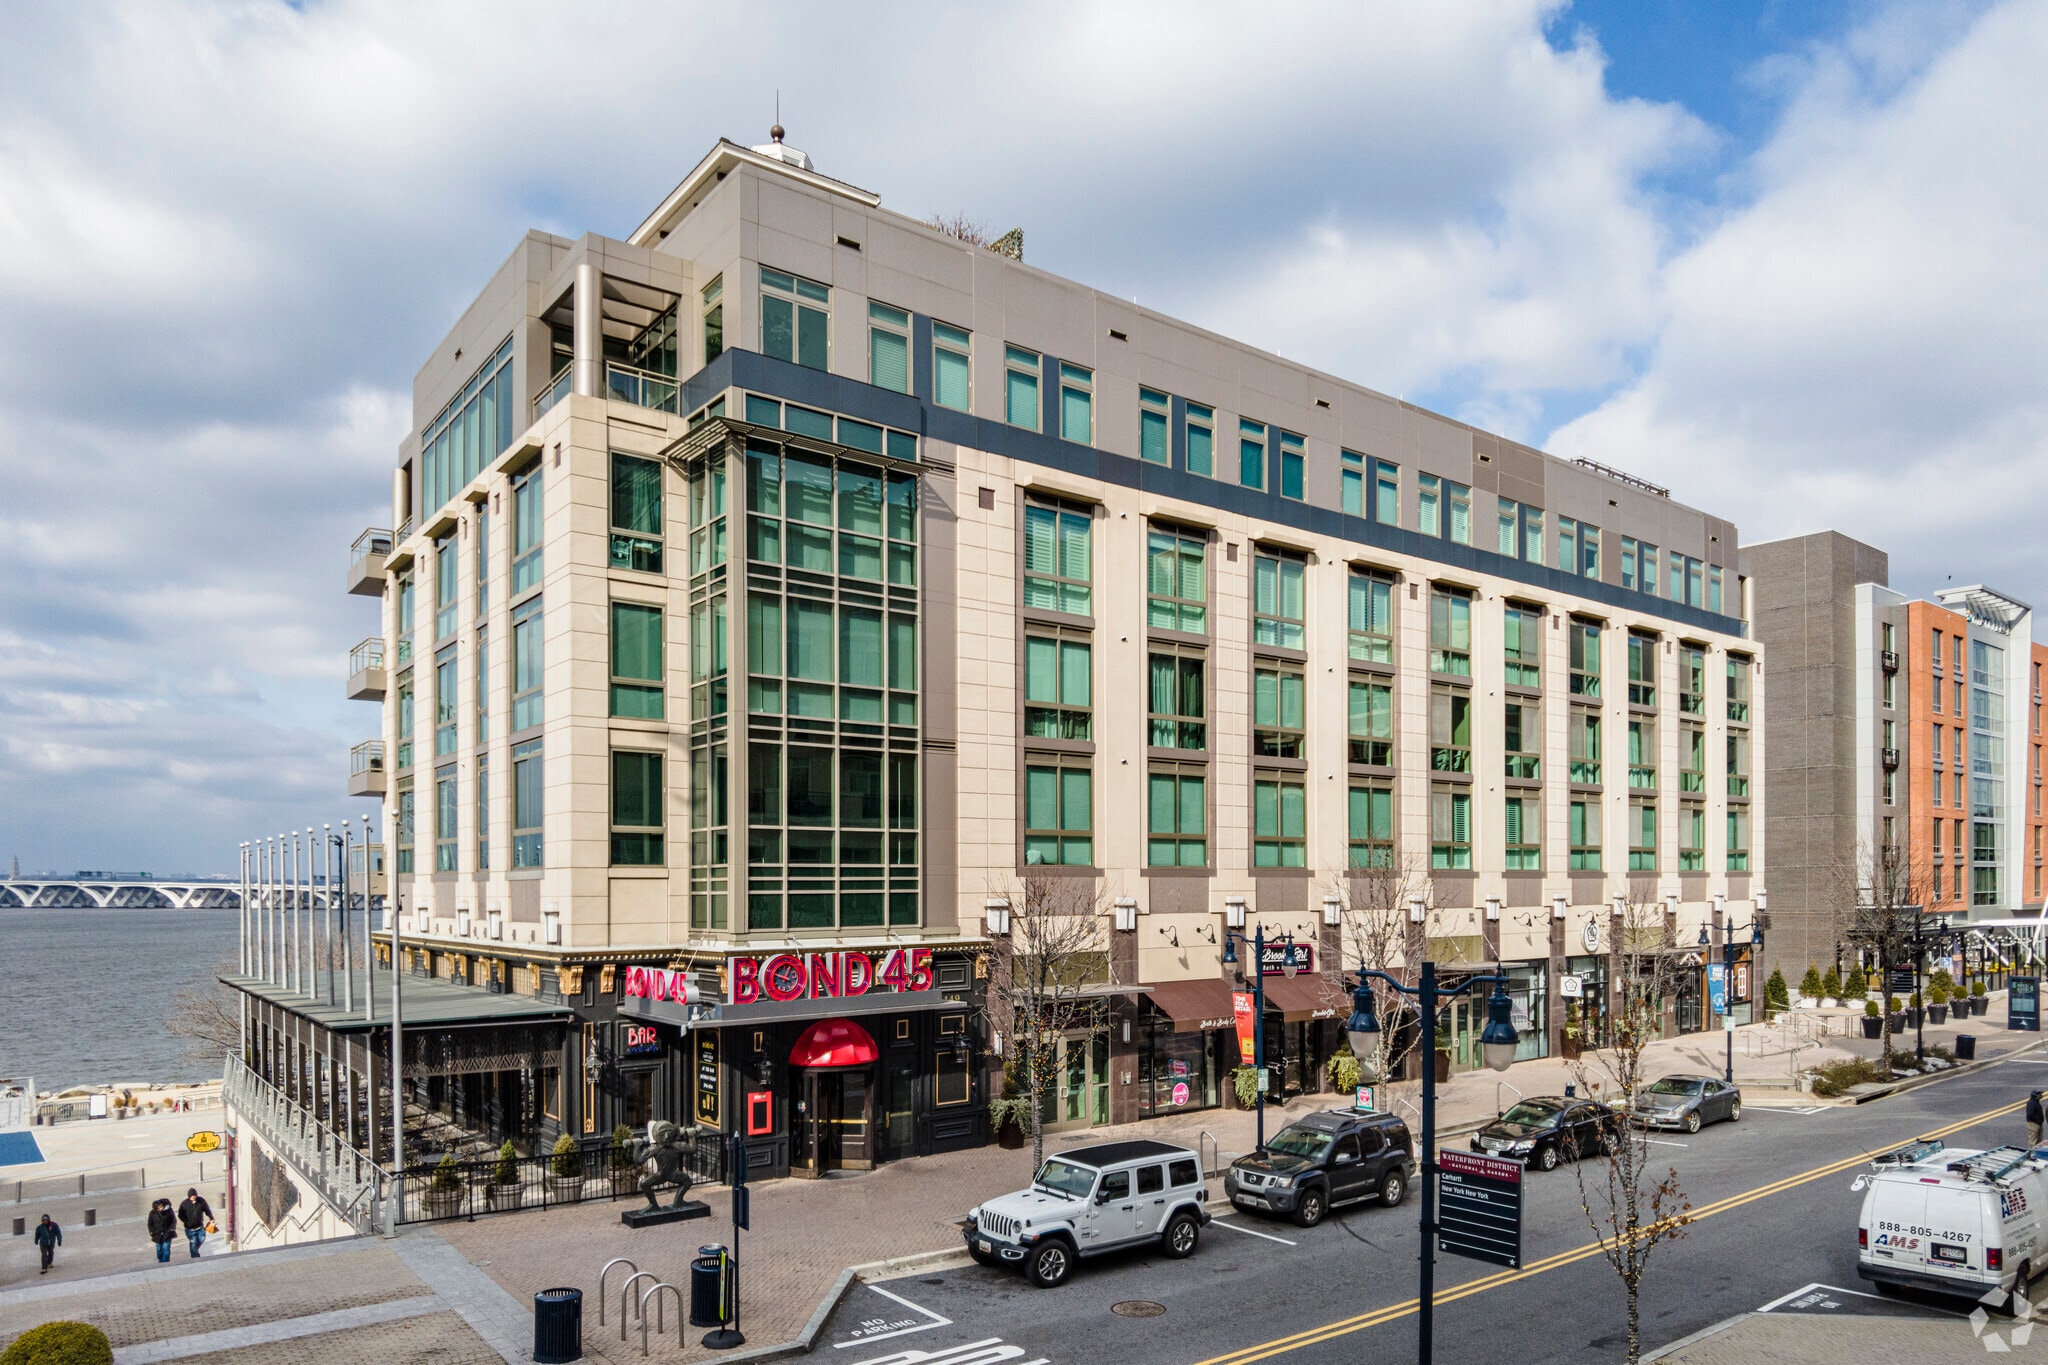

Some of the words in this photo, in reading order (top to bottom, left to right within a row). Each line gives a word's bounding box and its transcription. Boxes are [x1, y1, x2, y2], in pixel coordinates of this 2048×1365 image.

[730, 951, 872, 1004] BOND
[881, 948, 933, 993] 45
[625, 965, 667, 1002] BOND
[669, 971, 688, 1006] 45
[628, 1026, 657, 1047] BAR
[1442, 1153, 1485, 1167] WATERFRONT
[1441, 1172, 1462, 1182] Carhartt
[1452, 1163, 1478, 1172] NATIONAL
[1486, 1169, 1509, 1178] HARBOR
[1441, 1184, 1453, 1193] New
[1453, 1186, 1465, 1195] York
[1465, 1188, 1477, 1197] New
[1477, 1191, 1489, 1200] York
[1879, 1221, 1972, 1243] 888-805-4267
[1874, 1233, 1920, 1250] AMS
[850, 1319, 917, 1337] PARKING
[860, 1318, 885, 1328] NO
